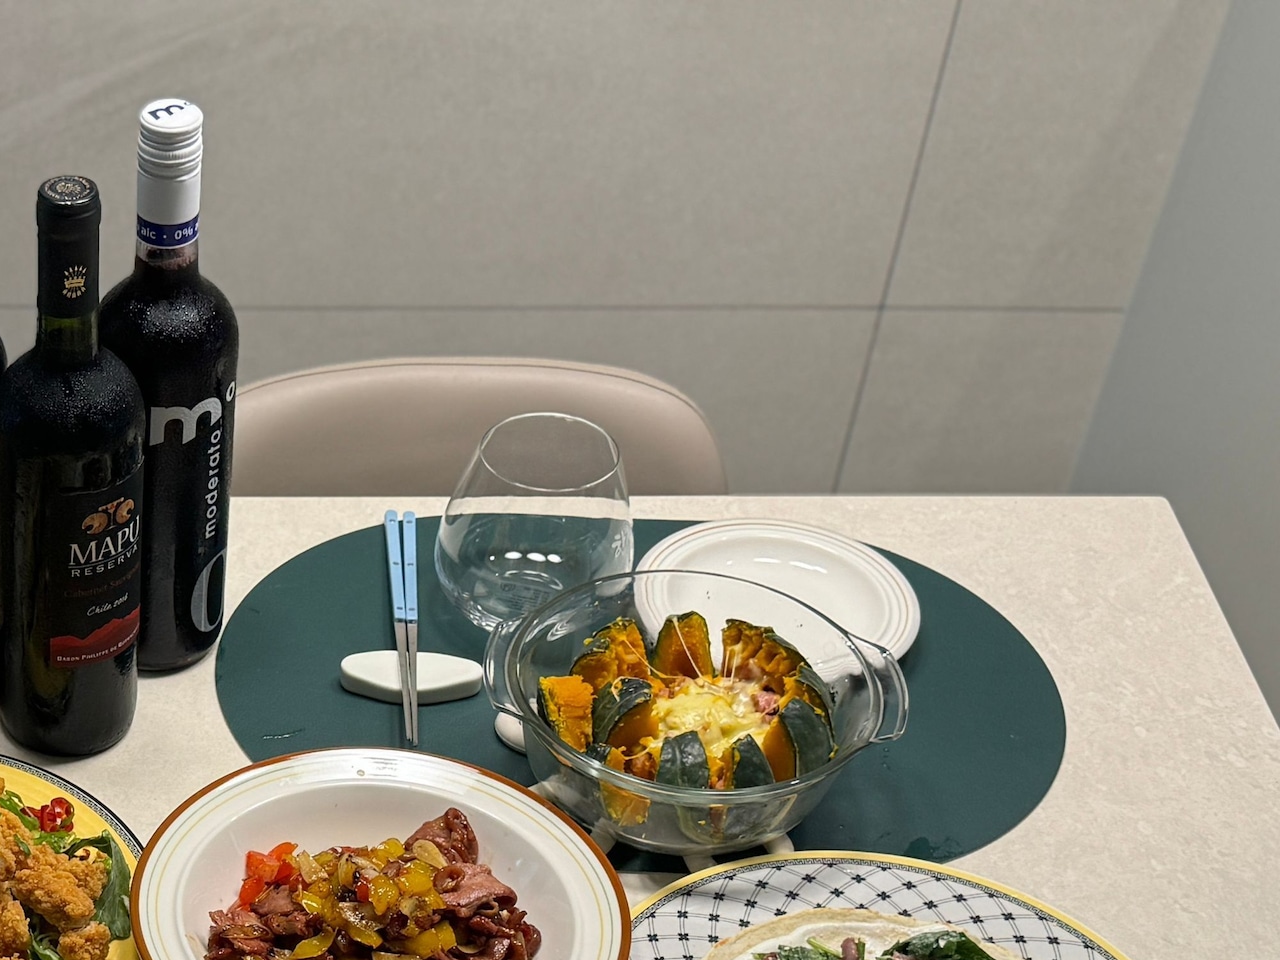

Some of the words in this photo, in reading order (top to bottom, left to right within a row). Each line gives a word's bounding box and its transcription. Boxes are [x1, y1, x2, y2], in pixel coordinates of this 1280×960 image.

[204, 429, 221, 540] moderato
[68, 514, 140, 566] MAPU
[71, 544, 138, 578] RESERVA
